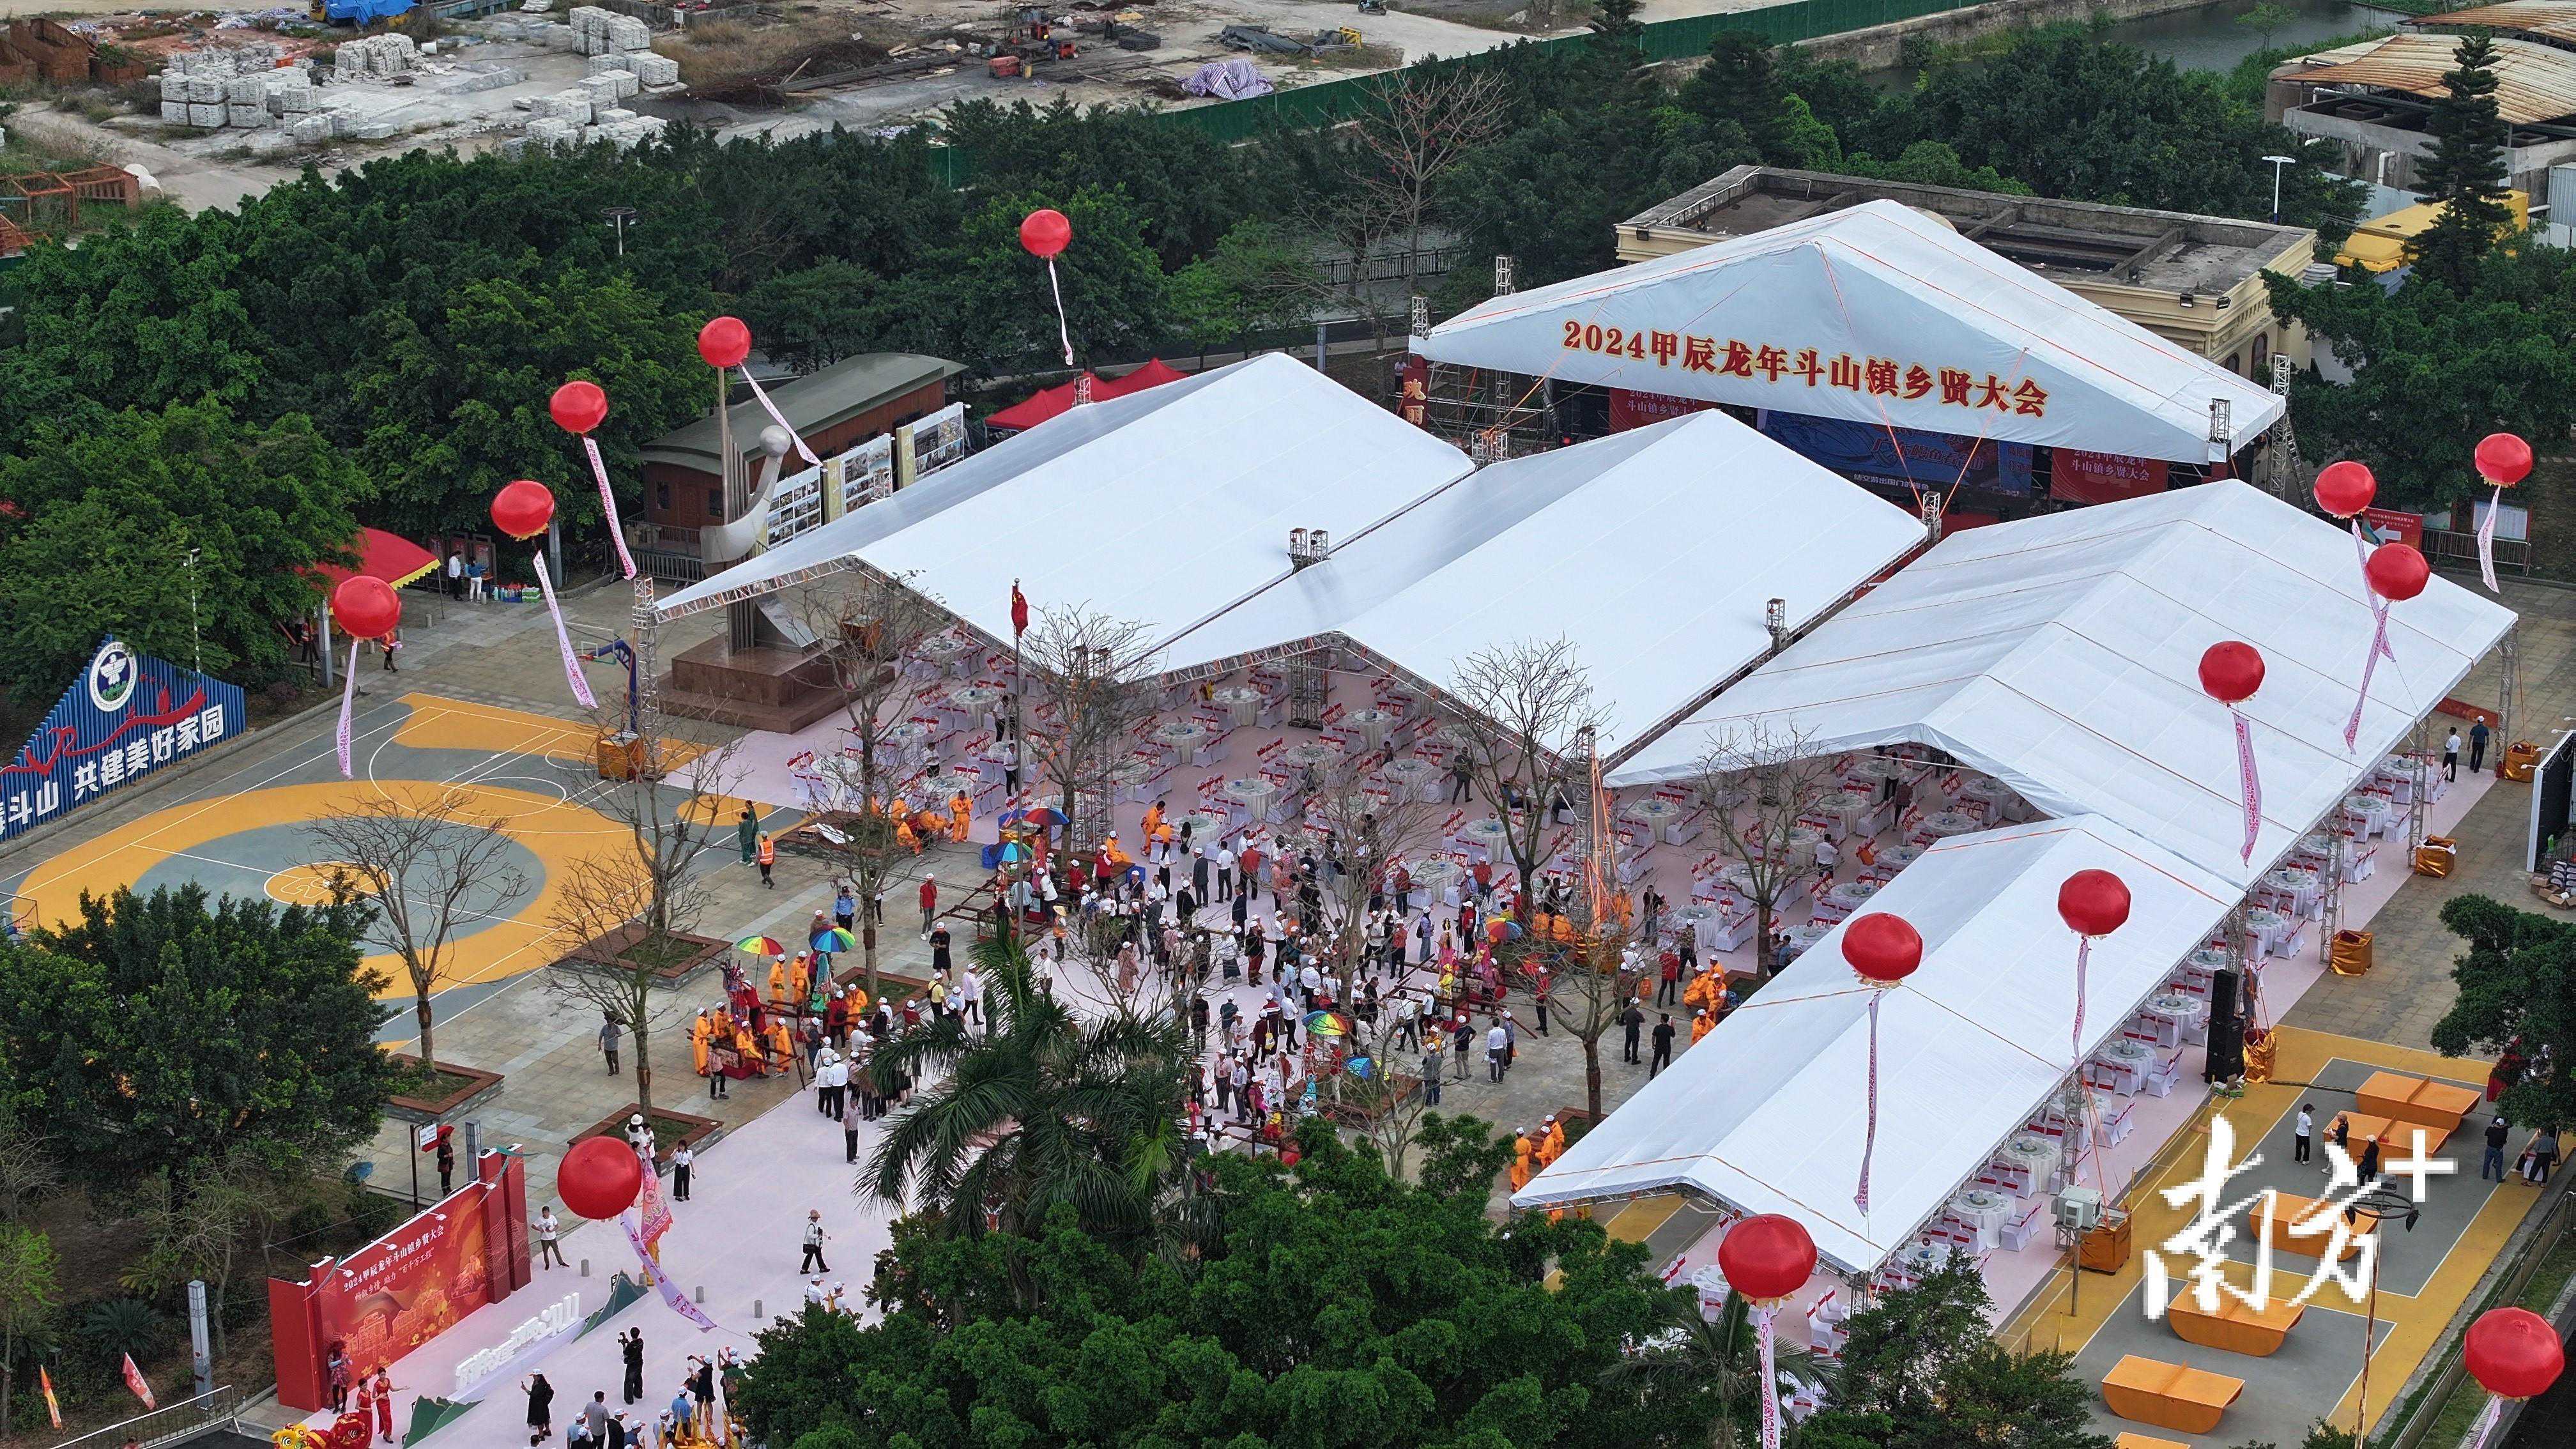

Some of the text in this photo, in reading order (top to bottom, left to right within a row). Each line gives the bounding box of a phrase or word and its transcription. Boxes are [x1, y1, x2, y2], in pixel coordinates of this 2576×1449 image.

[1561, 319, 2050, 419] 2024甲辰龙年斗山镇乡贤大会
[2071, 459, 2150, 482] 斗山镇乡贤大会
[0, 703, 224, 836] 斗山 共建美好家园
[344, 1225, 445, 1292] 2024甲辰龙年斗山镇乡贤大会
